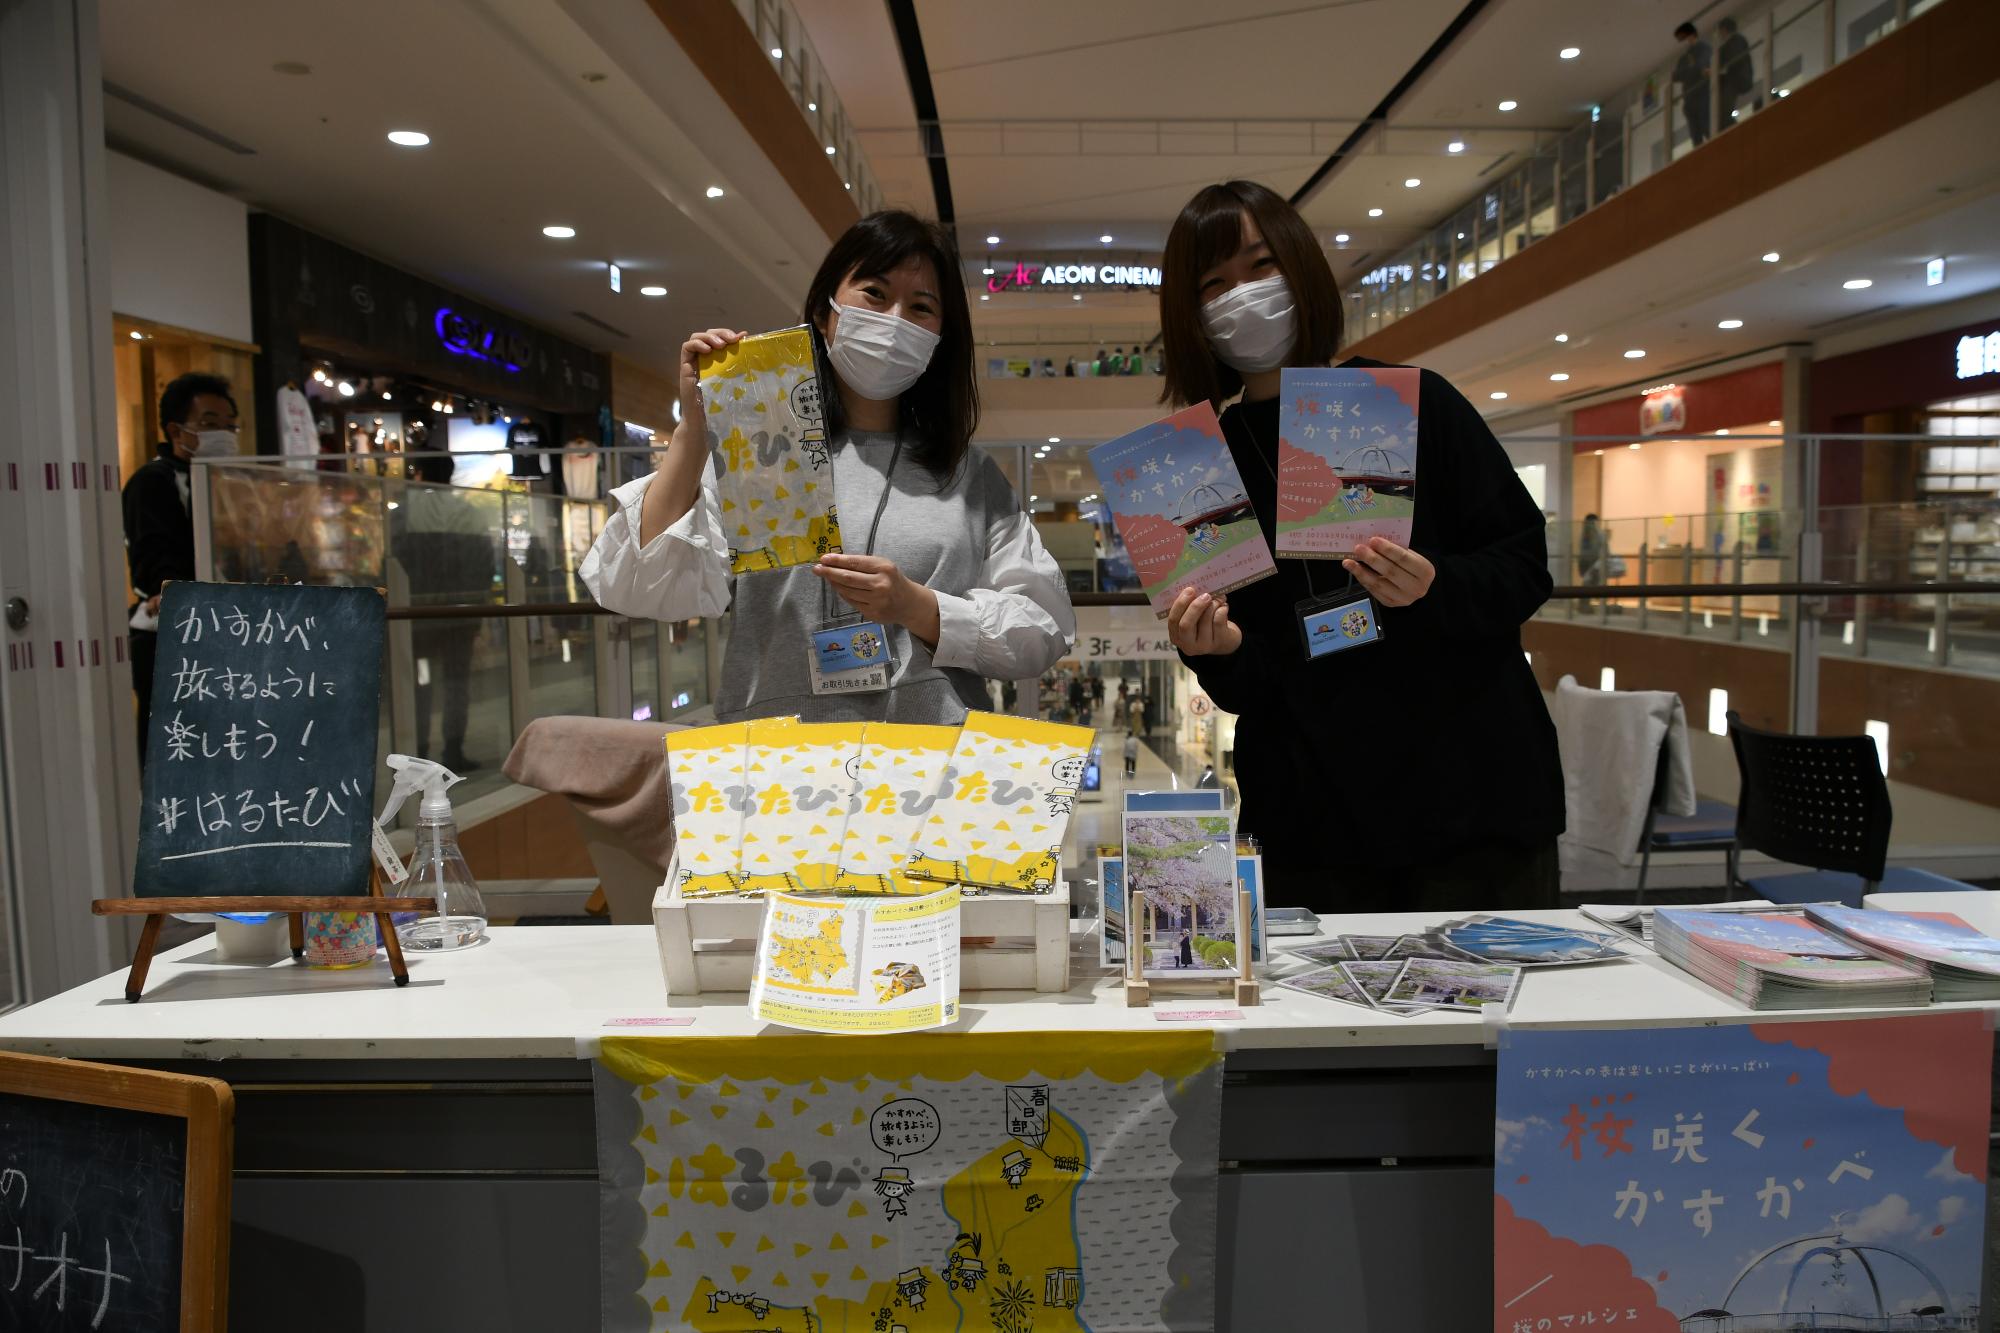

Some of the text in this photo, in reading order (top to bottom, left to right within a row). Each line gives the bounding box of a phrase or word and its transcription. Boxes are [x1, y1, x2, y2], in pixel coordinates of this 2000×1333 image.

[1041, 265, 1096, 284] AEON
[1090, 637, 1112, 656] 3F
[172, 657, 336, 702] 旅するように
[821, 679, 869, 689] お取引先さま
[880, 1120, 934, 1132] 旅するように
[1011, 1088, 1048, 1133] 春日部
[1560, 1093, 1766, 1164] 桜咲く
[669, 1143, 870, 1212] はるたび
[1613, 1150, 1875, 1238] かすかべ
[1512, 1307, 1638, 1333] 桜のマルシェ
